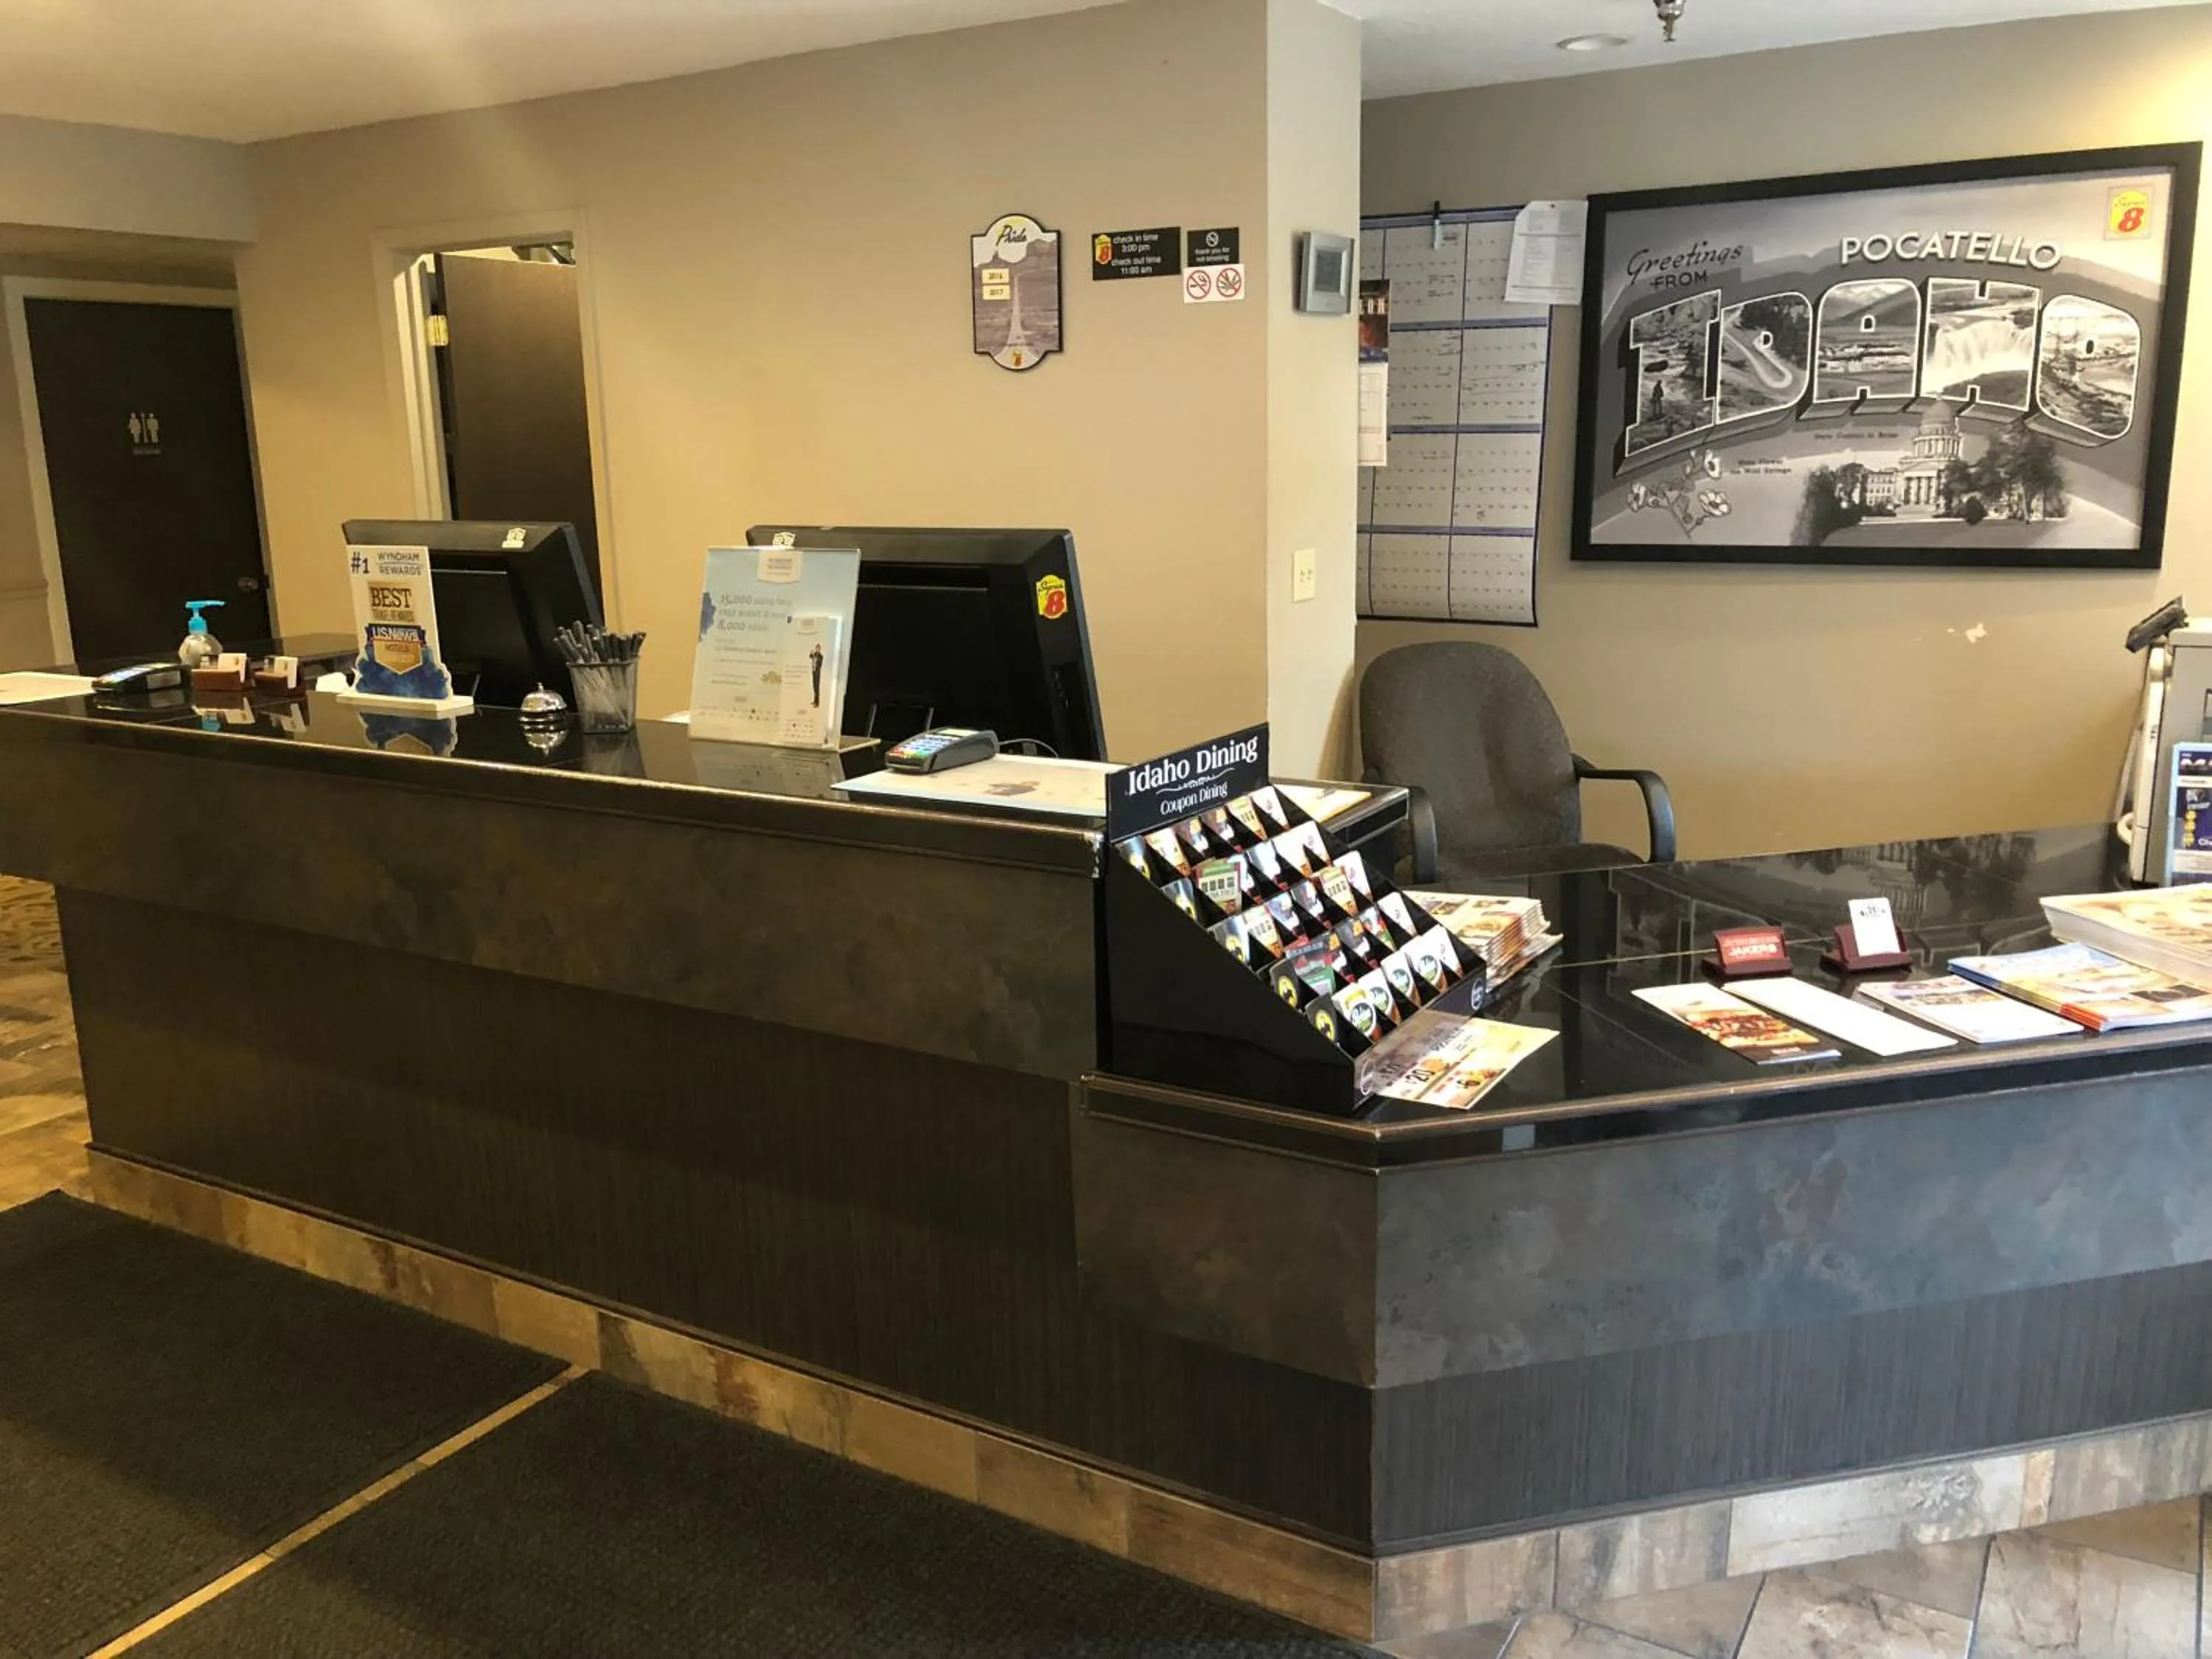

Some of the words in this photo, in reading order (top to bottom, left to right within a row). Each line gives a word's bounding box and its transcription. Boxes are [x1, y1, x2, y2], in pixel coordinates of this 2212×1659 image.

[2118, 207, 2144, 233] 8
[995, 224, 1028, 246] Pride
[1112, 236, 1133, 244] check
[1143, 233, 1158, 242] time
[1138, 244, 1151, 253] pm
[1840, 230, 2062, 270] POCATELLO
[1111, 258, 1132, 266] check
[1133, 256, 1144, 265] out
[1145, 255, 1162, 264] time
[1140, 265, 1152, 274] am
[1627, 240, 1744, 286] Greetings
[1649, 269, 1708, 289] FROM
[1622, 277, 2143, 459] IDAHO
[351, 551, 370, 574] #1
[377, 552, 420, 562] WYNDHAM
[378, 566, 422, 576] REWARDS
[369, 586, 412, 608] BEST
[1044, 589, 1065, 617] 8
[1128, 758, 1191, 796] Idaho
[1197, 735, 1259, 774] Dining
[1160, 793, 1198, 815] Coupon
[1200, 781, 1228, 802] Dining
